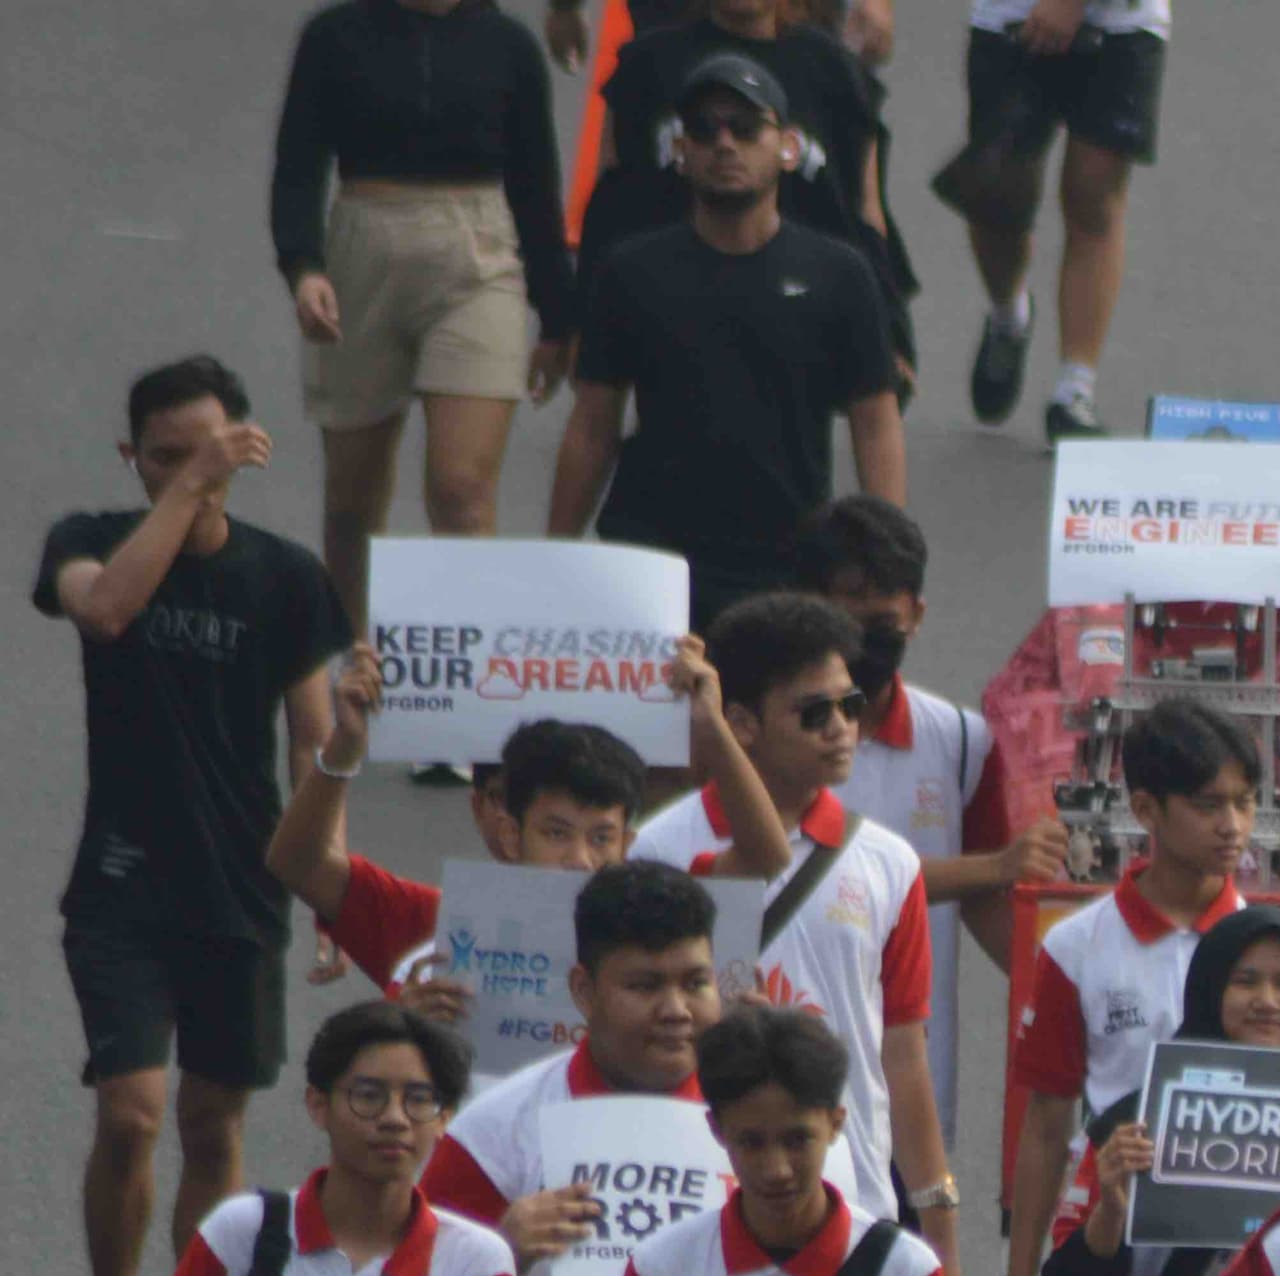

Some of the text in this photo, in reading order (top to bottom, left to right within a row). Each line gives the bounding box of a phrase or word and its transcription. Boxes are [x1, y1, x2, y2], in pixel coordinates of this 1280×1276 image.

[1068, 500, 1120, 517] WE
[1130, 501, 1198, 518] ARE
[376, 625, 483, 654] KEEP
[378, 655, 474, 690] OUR
[572, 1162, 707, 1198] MORE
